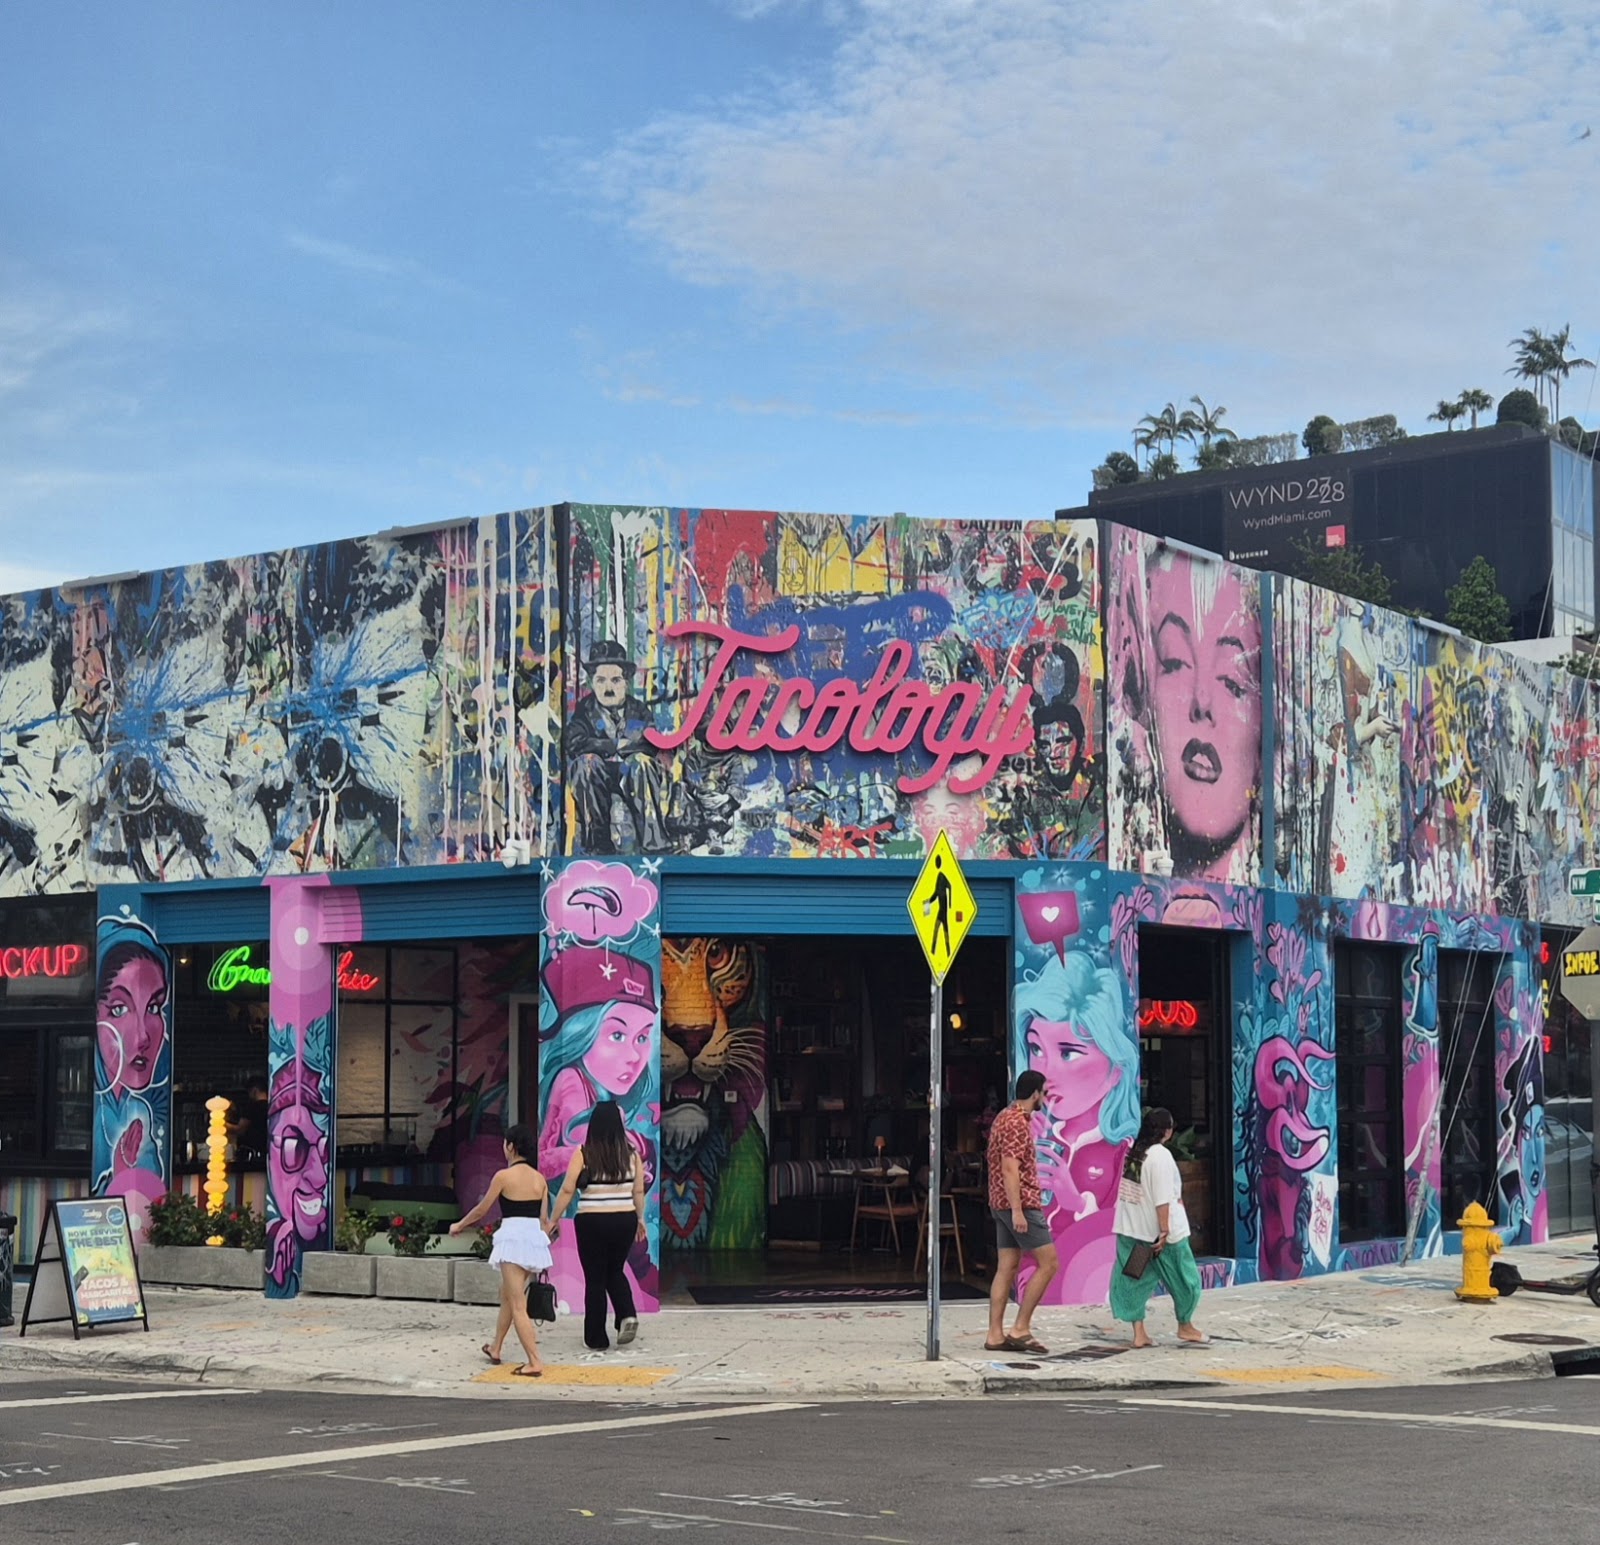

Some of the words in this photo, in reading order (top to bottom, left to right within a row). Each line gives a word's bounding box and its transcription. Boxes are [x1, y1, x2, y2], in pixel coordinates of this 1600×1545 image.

[1229, 482, 1303, 510] WYND
[1243, 509, 1332, 530] WyndMiami.com
[643, 621, 1034, 795] Tacology
[1571, 876, 1587, 891] NW
[68, 1229, 88, 1238] NOW
[69, 1237, 93, 1248] THE
[95, 1235, 123, 1247] BEST
[81, 1277, 119, 1290] TACOS
